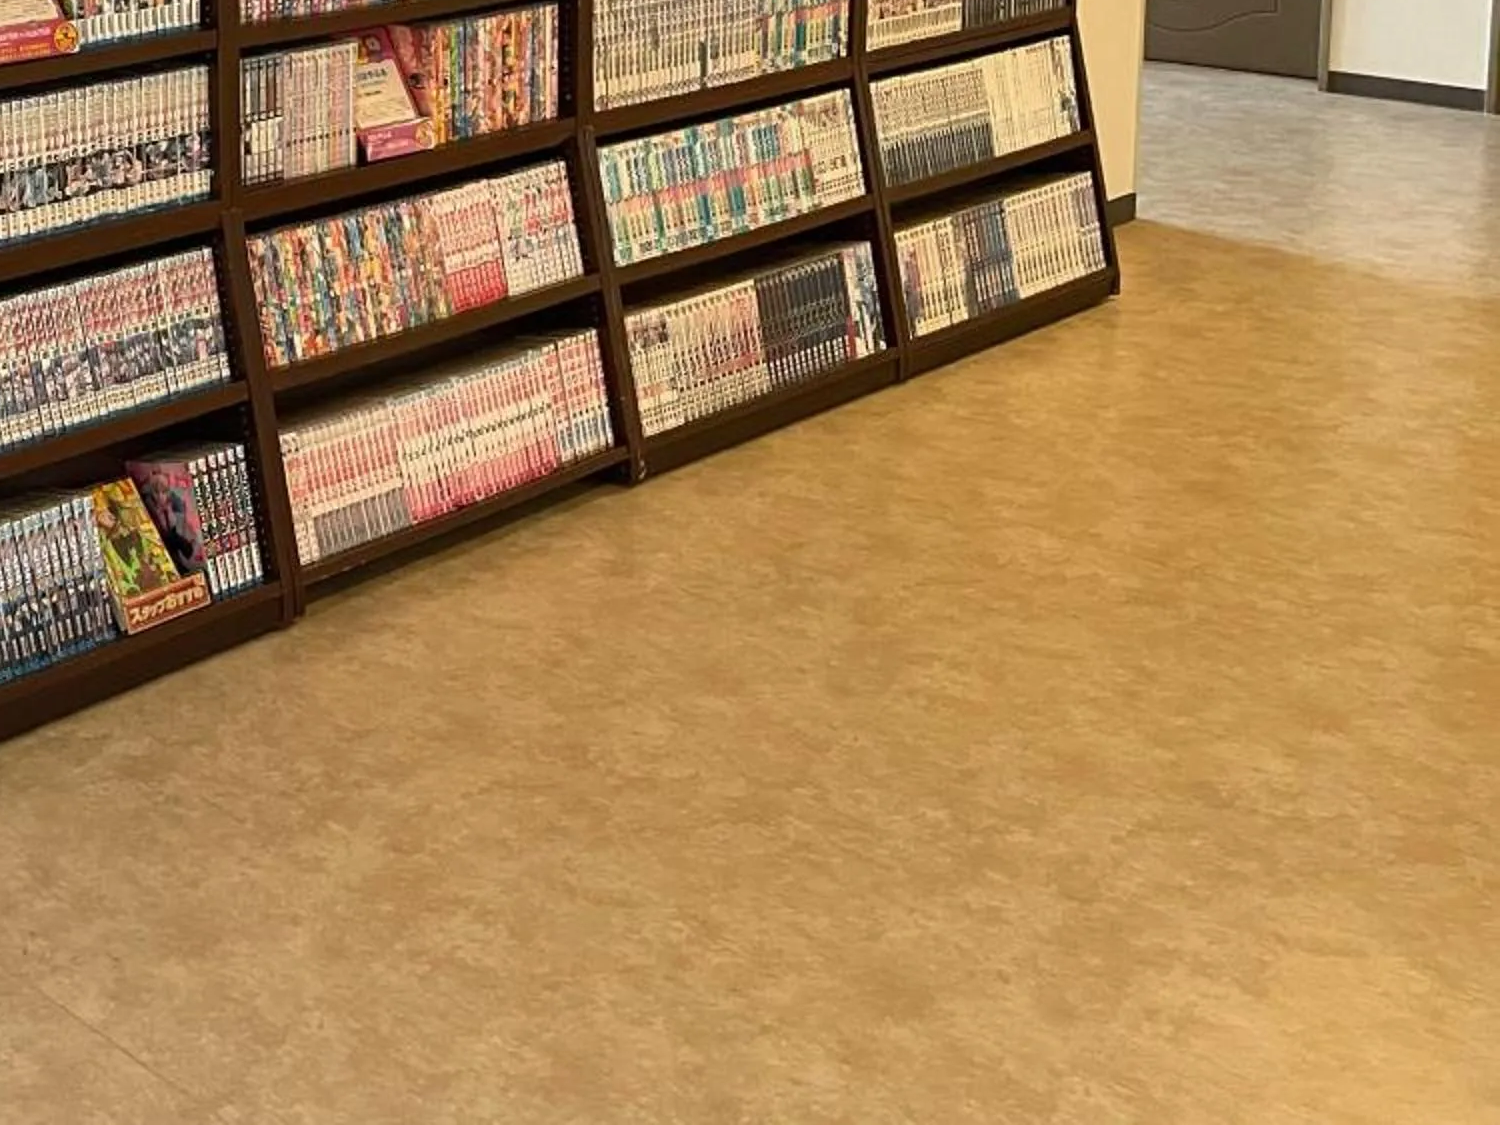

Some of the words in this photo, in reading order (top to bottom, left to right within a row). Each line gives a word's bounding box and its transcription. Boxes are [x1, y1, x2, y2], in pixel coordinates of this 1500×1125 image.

[129, 586, 204, 624] スタッフおすすめ
